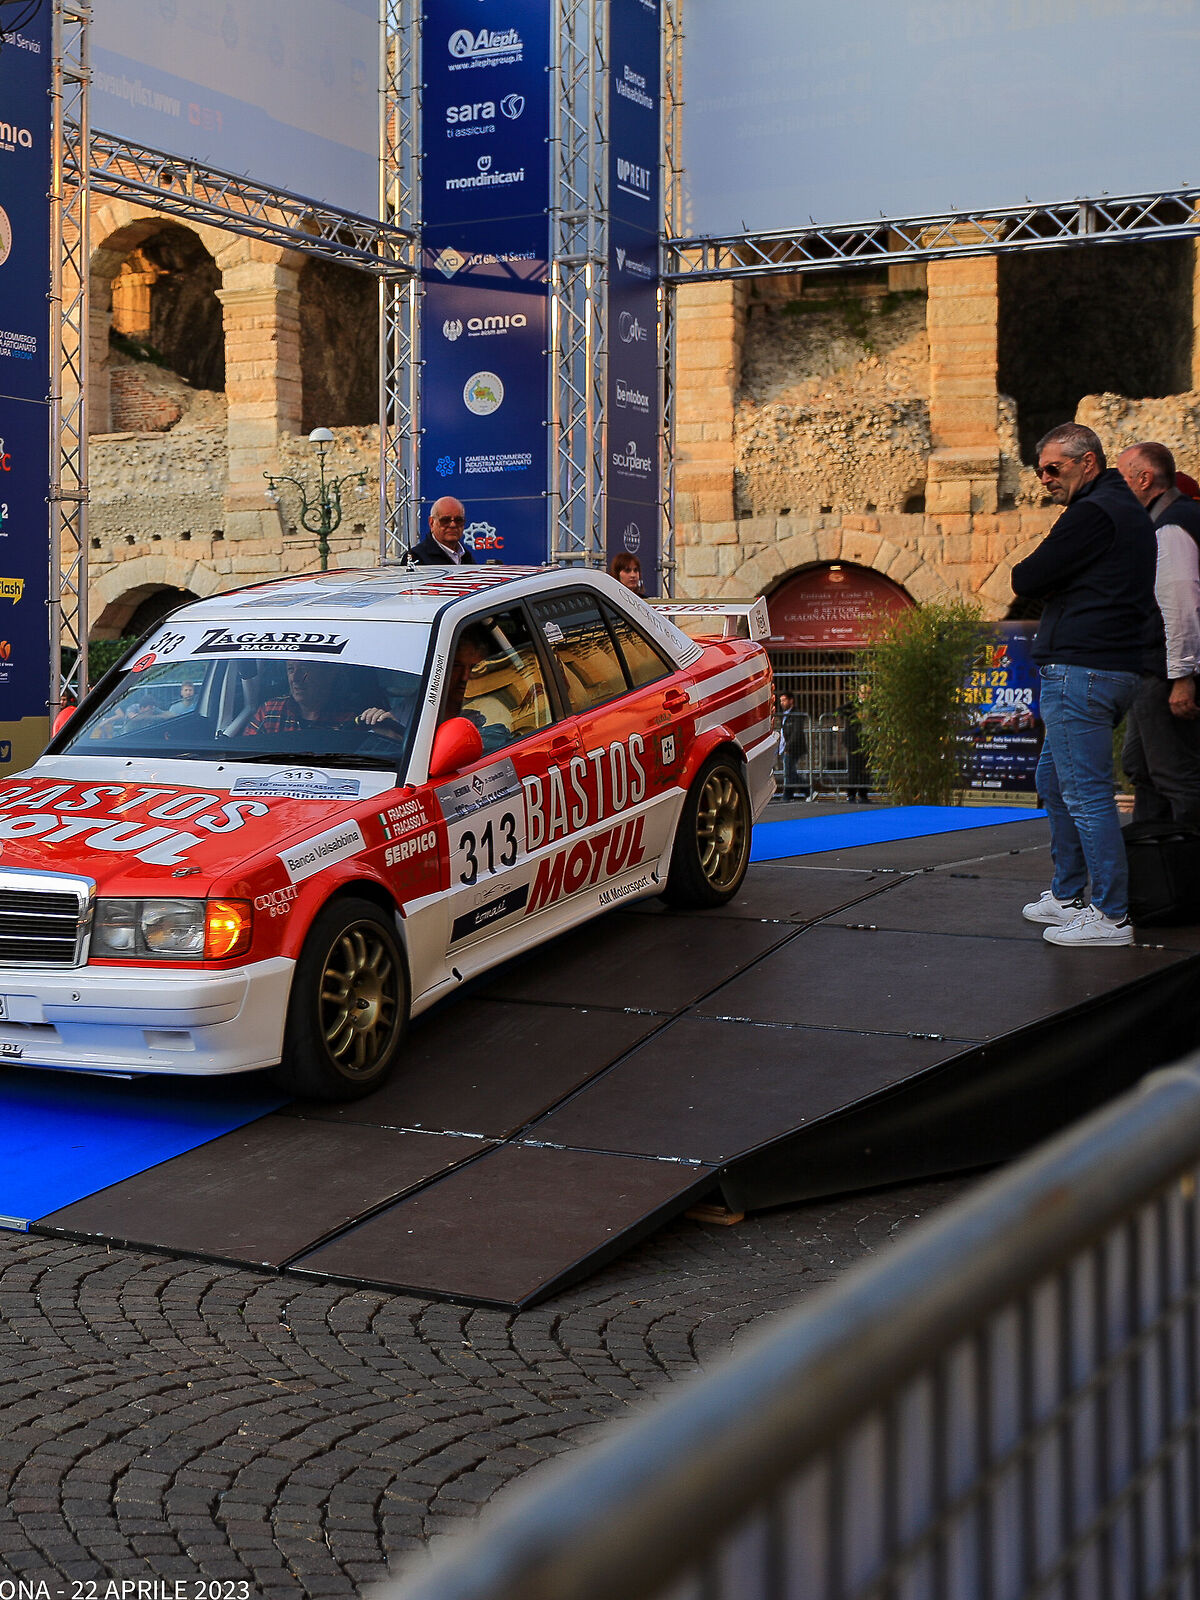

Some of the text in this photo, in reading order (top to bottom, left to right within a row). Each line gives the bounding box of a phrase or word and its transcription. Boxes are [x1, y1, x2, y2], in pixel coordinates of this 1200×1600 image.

[474, 28, 520, 50] Aleph
[448, 54, 523, 71] www.alephgroup.it
[623, 64, 646, 88] Banca
[446, 101, 496, 124] sara
[455, 124, 496, 137] assicura
[446, 168, 524, 190] mondinicavi
[483, 253, 508, 265] Global
[509, 250, 536, 263] Servizi
[467, 313, 527, 331] amia
[4, 331, 37, 345] COMMERCIO
[465, 455, 489, 463] CAMERA
[496, 453, 531, 461] COMMERCIO
[475, 537, 504, 550] SEC
[150, 631, 186, 655] 313
[191, 628, 349, 654] ZAGARDI
[428, 654, 445, 706] AM Motorsport
[996, 688, 1033, 705] 2023
[283, 772, 314, 780] 313
[245, 791, 344, 799] CONCORRENTE
[522, 732, 646, 853] BASTOS
[389, 801, 417, 823] FRACASSO
[394, 817, 420, 837] FRACASSO
[287, 830, 360, 871] Banca Valsabbina
[385, 830, 437, 867] SERPICO
[459, 812, 518, 885] 313
[523, 815, 646, 916] MOTUL
[598, 875, 650, 907] AM Motorsport
